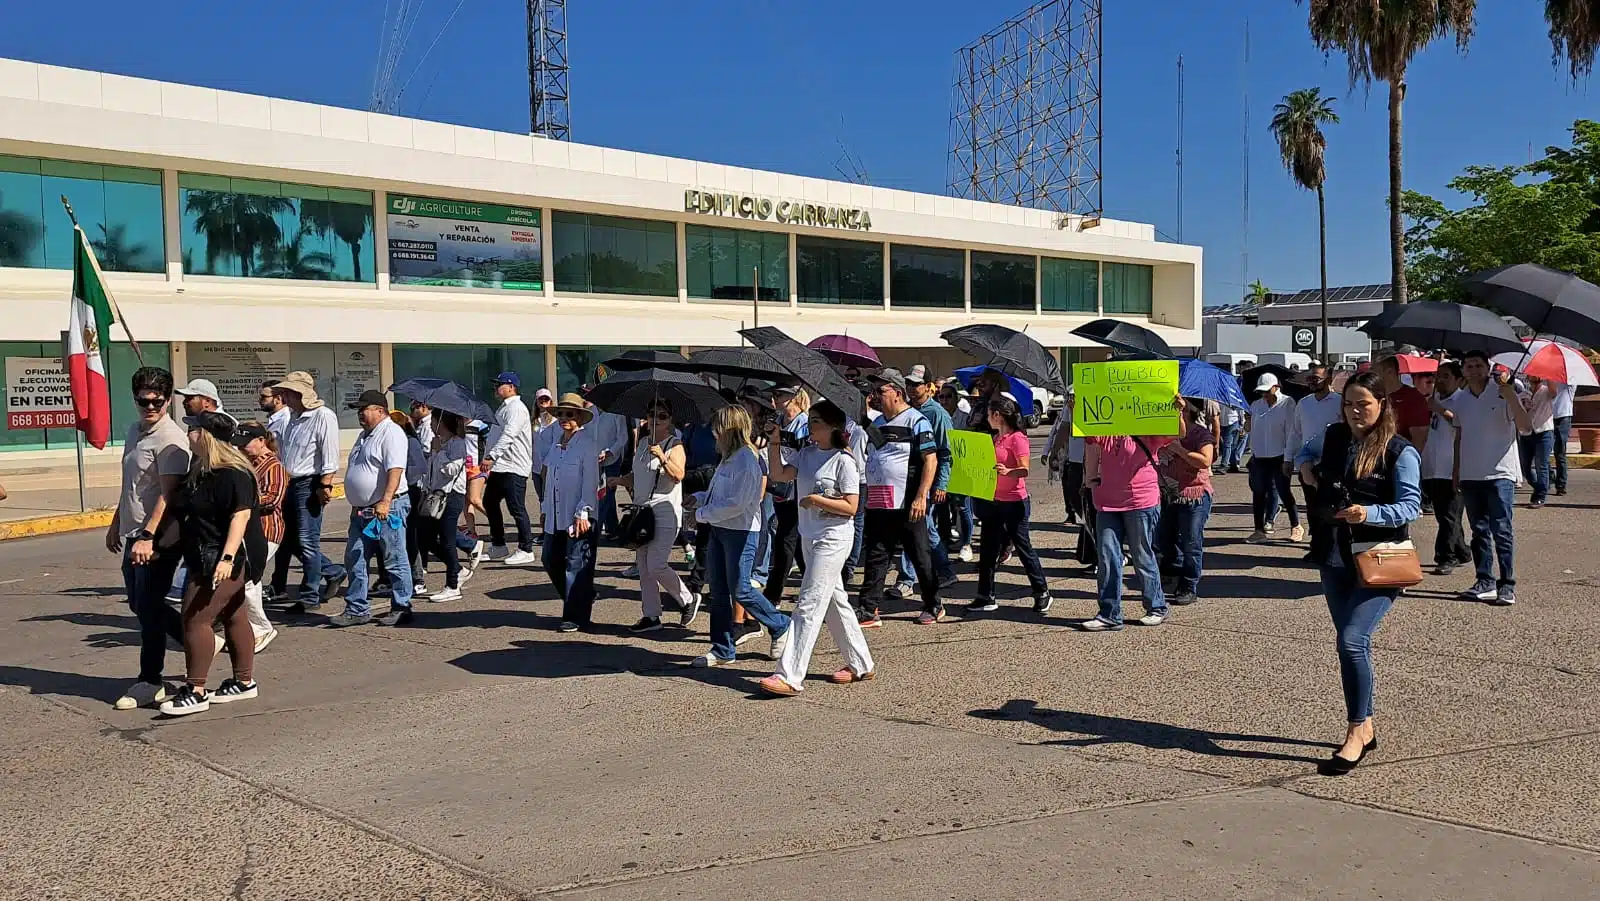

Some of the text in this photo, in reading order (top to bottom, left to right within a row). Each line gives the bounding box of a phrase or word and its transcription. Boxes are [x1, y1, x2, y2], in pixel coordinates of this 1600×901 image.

[420, 203, 482, 216] AGRICULTURE
[685, 190, 872, 231] EDIFICIO CARRANZA
[454, 225, 480, 233] VENTA
[447, 234, 495, 244] REPARACIÓN
[1108, 366, 1168, 382] PUEBLO
[10, 396, 72, 406] EN RENT
[1082, 395, 1114, 422] NO
[12, 413, 76, 426] 668 136 008
[952, 437, 967, 459] NO
